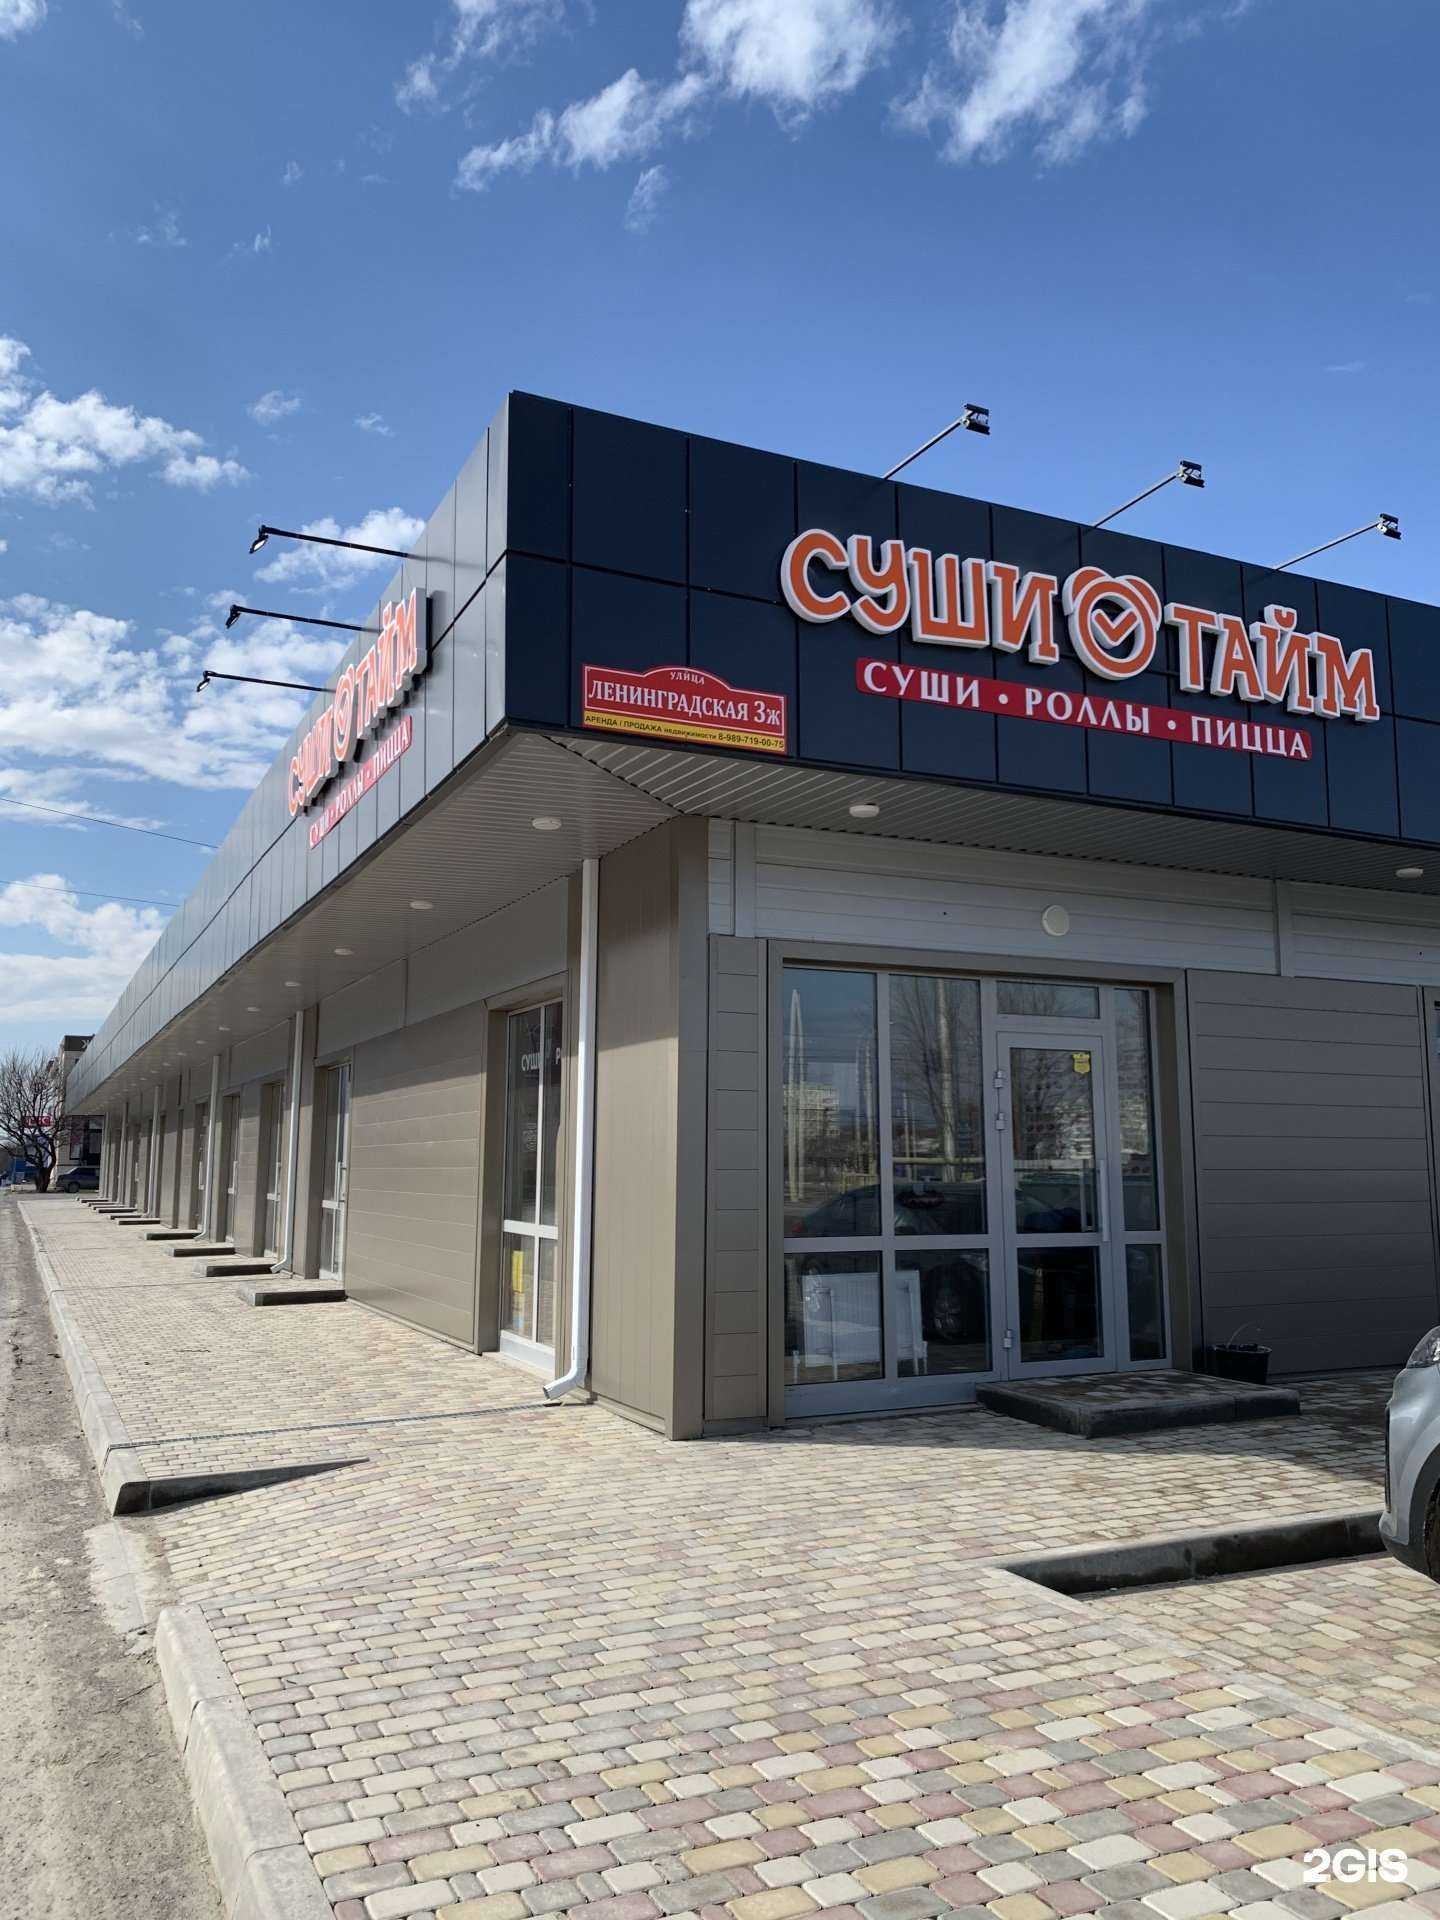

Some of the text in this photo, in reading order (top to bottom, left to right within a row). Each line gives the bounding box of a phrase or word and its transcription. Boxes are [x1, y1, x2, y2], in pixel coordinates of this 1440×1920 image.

[356, 587, 418, 739] ТАЙМ
[780, 528, 1381, 722] СУШИ ТАЙМ
[585, 715, 618, 727] АРЕНДА
[624, 719, 662, 734] ПРОДАЖА
[588, 680, 749, 721] ЛЕНИНГРАДСКАЯ
[863, 661, 1309, 759] СУШИ РОЛЛЫ ПИЦЦА
[373, 720, 409, 778] ПИЦЦА
